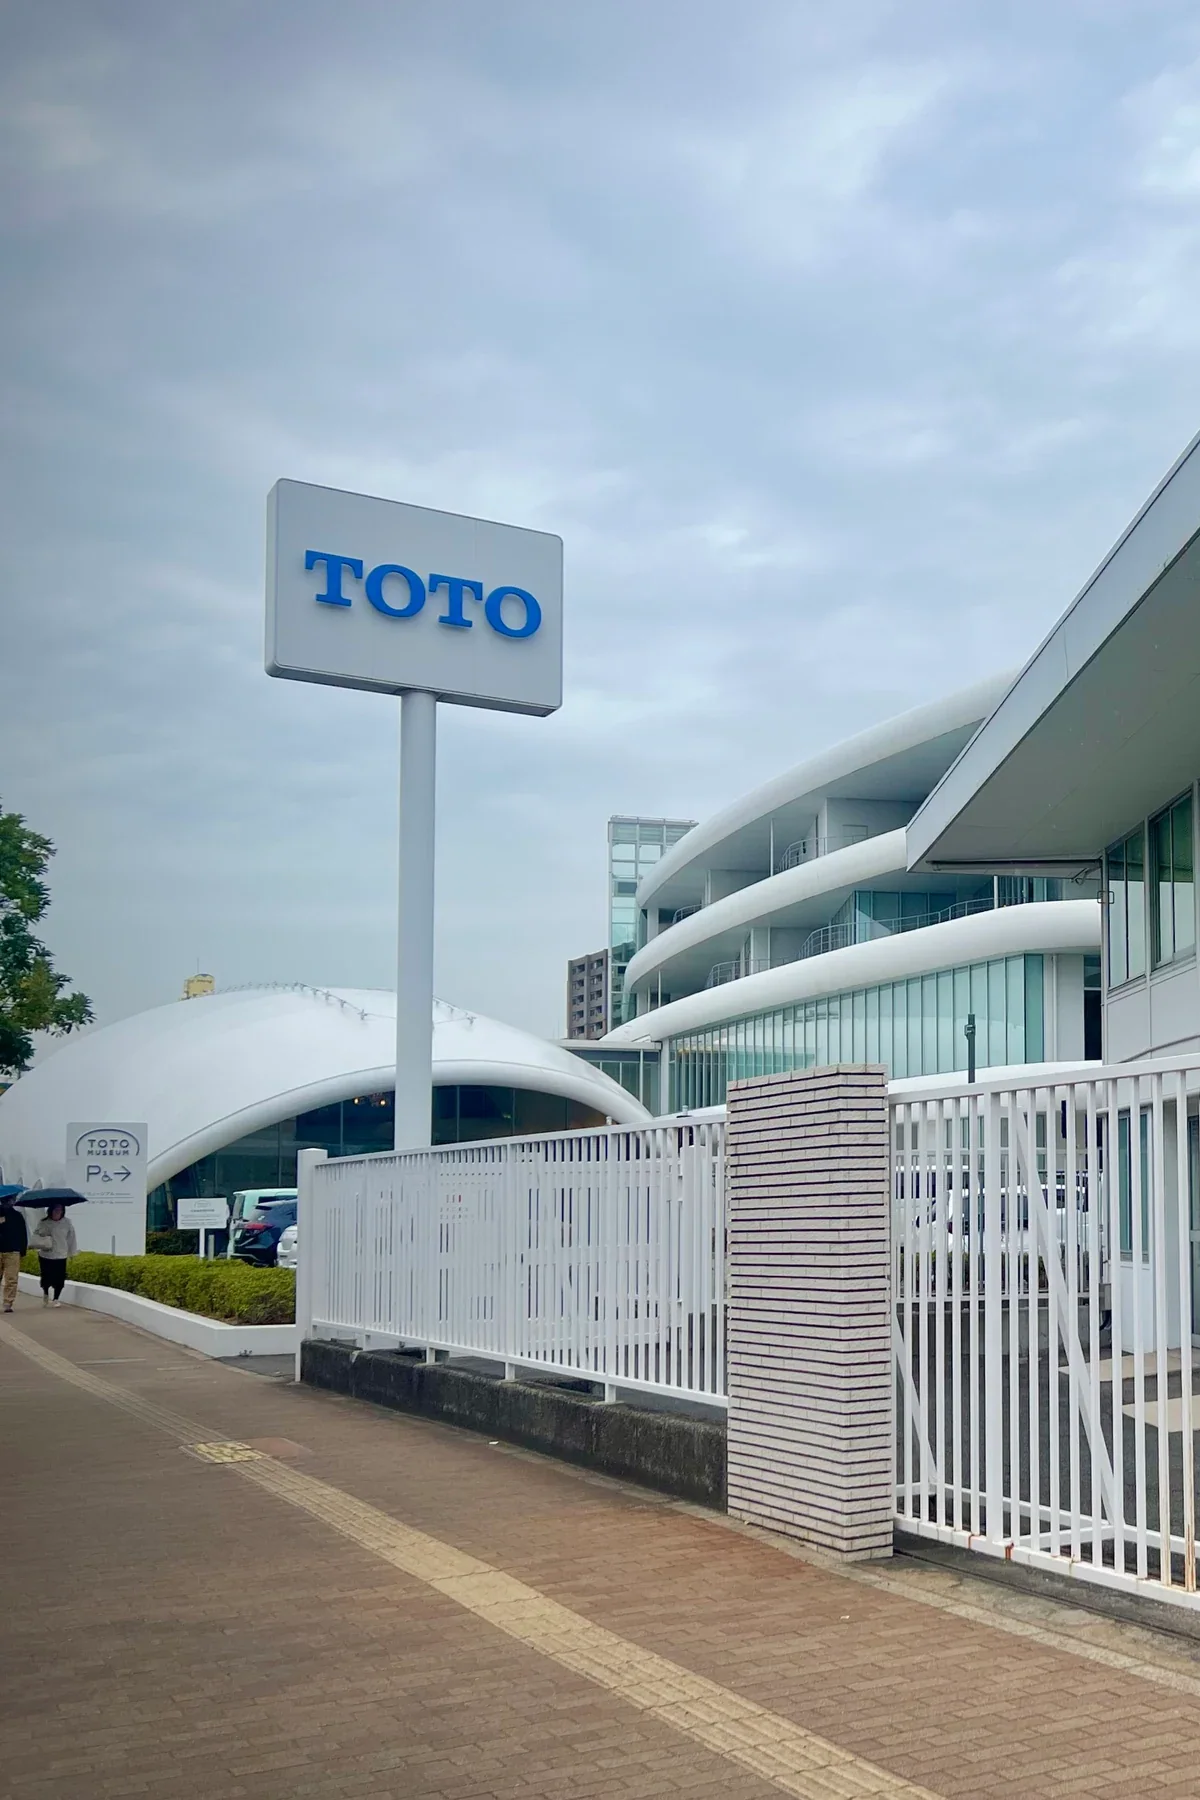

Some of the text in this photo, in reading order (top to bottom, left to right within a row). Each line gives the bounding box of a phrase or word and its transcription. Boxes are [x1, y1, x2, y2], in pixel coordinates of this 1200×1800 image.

[304, 549, 542, 639] TOTO
[87, 1139, 129, 1148] TOTO
[86, 1165, 101, 1182] P
